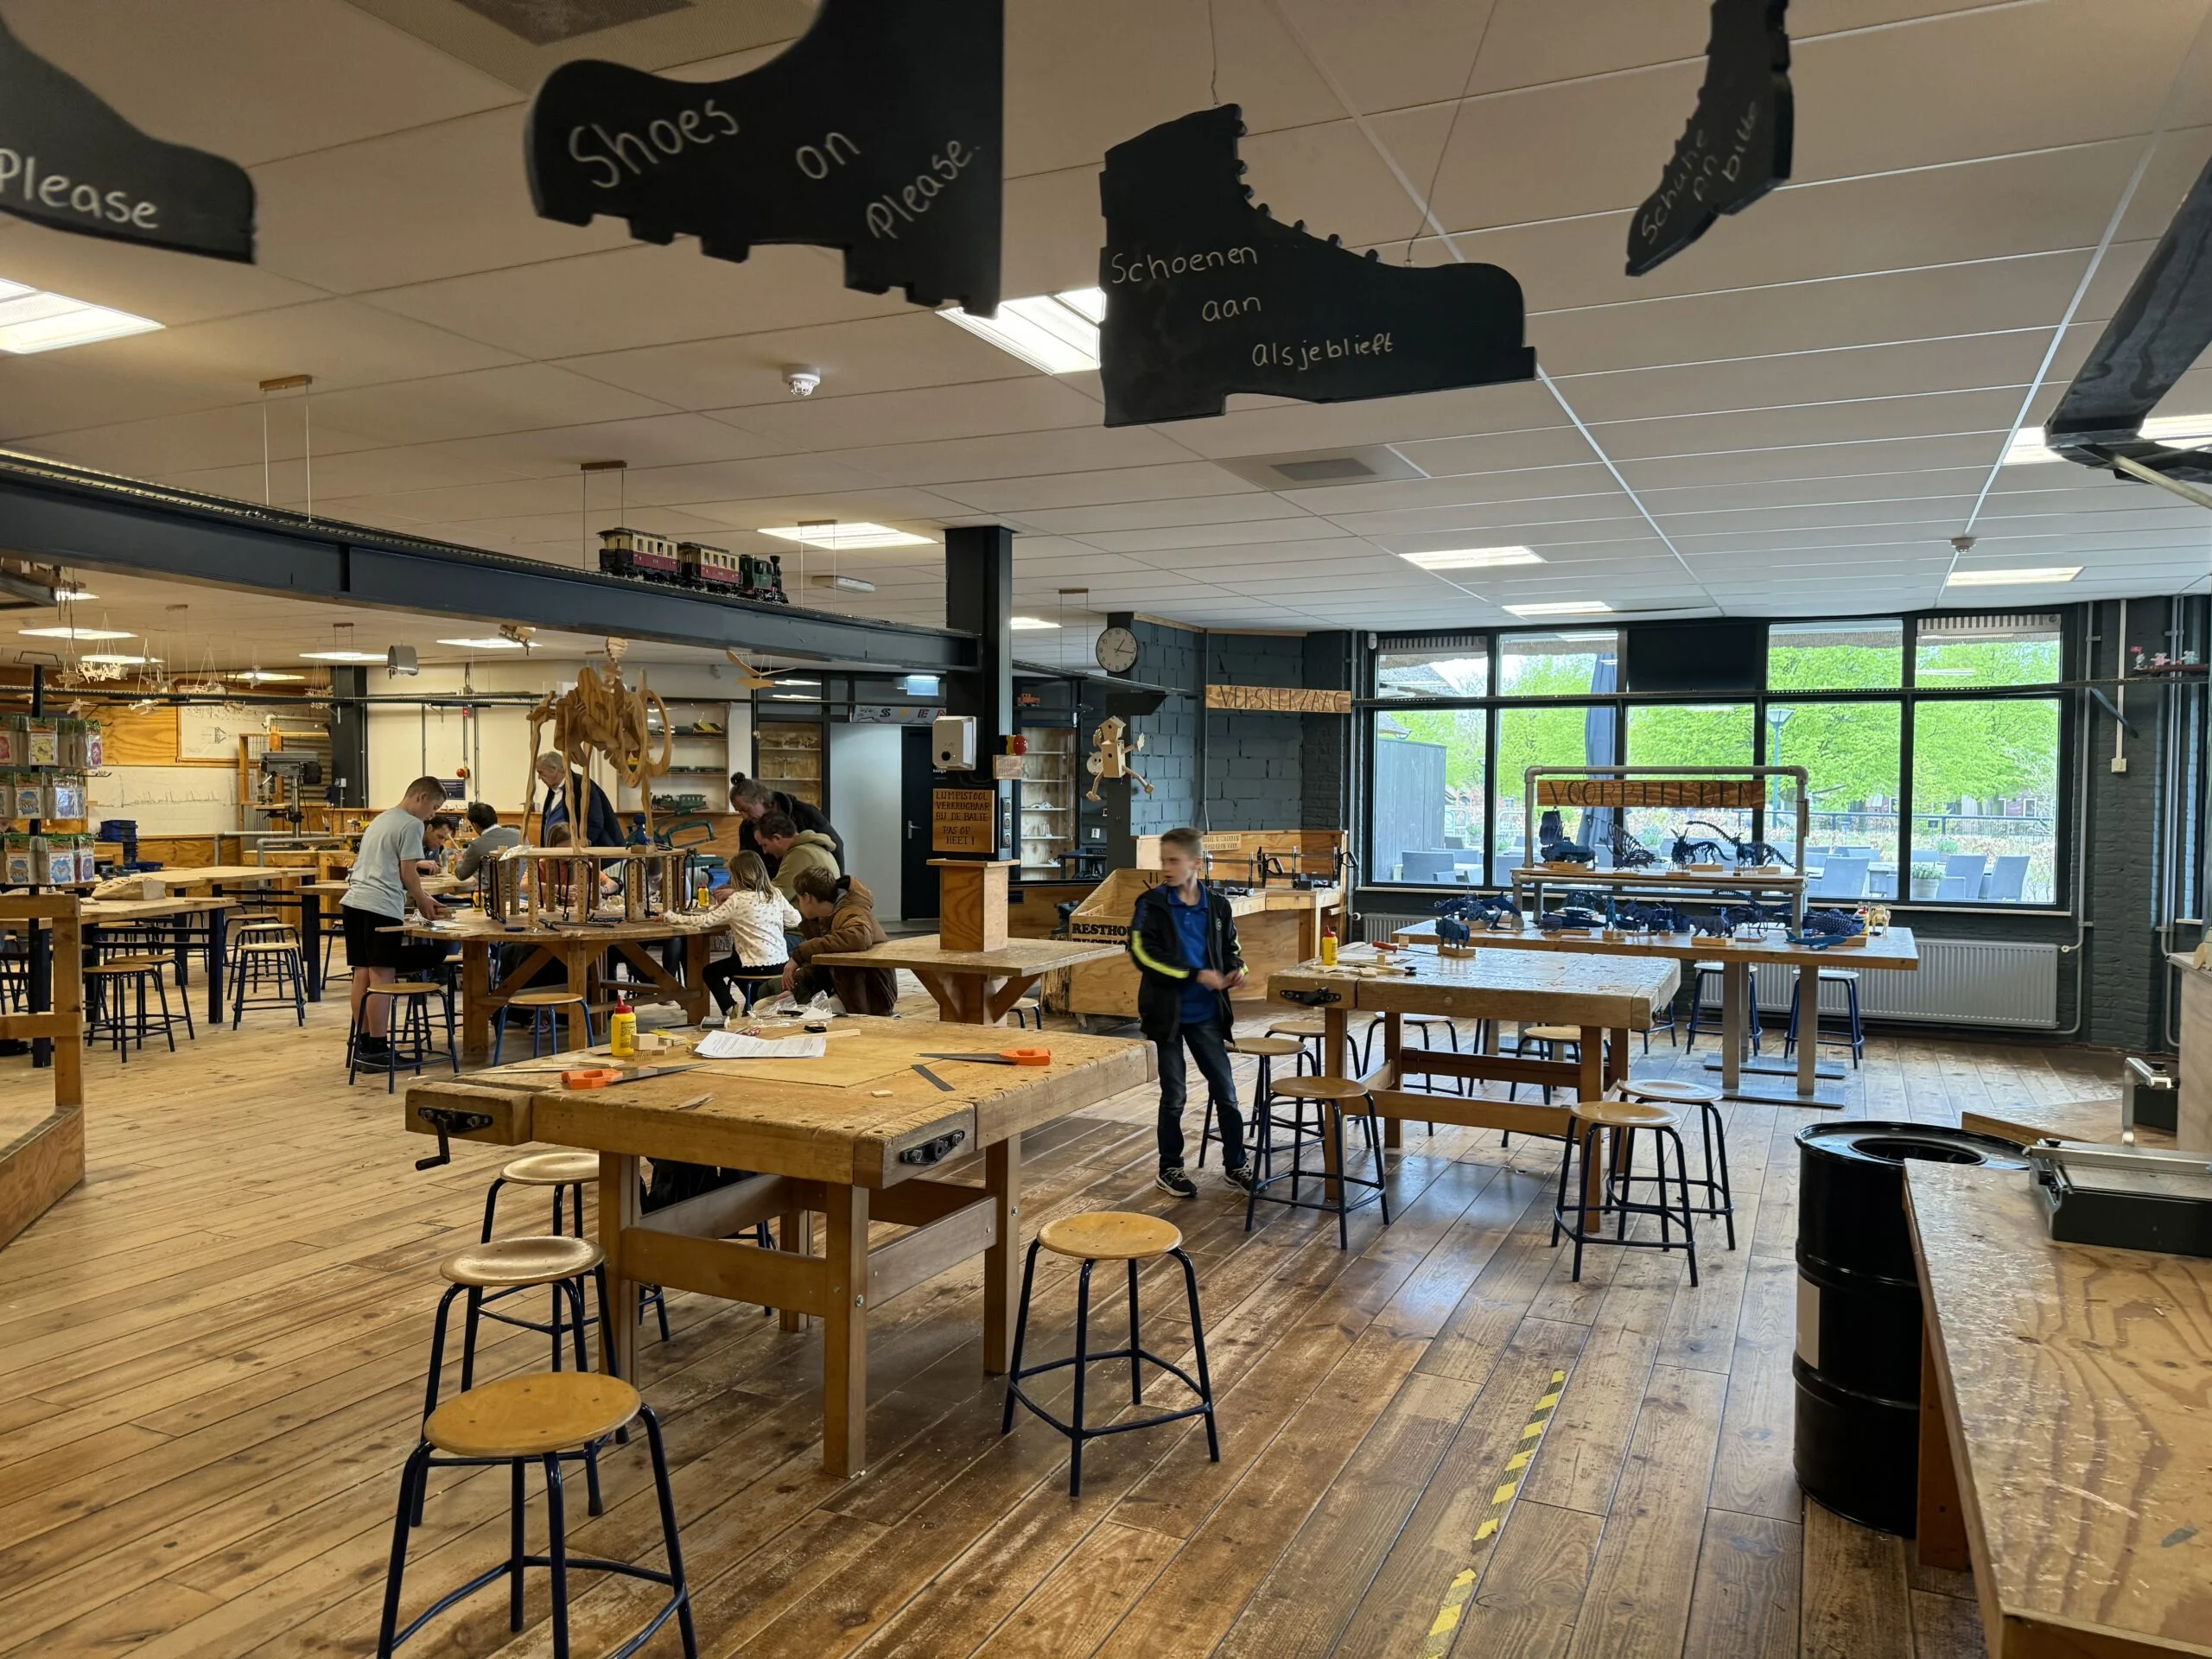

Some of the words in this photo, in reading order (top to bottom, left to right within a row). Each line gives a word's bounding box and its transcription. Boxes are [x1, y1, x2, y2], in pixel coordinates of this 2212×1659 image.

[569, 99, 740, 188] Shoes
[796, 132, 861, 180] on
[0, 147, 159, 230] Please
[867, 139, 973, 239] Please
[1111, 245, 1258, 284] Schoenen
[1202, 295, 1262, 322] aan
[936, 791, 988, 800] LIJMPISTOOL
[1548, 781, 1753, 806] VOORBEELDEN
[943, 825, 958, 835] PAS
[960, 826, 971, 835] OP
[951, 812, 961, 821] DE
[1071, 923, 1131, 937] RESTHO
